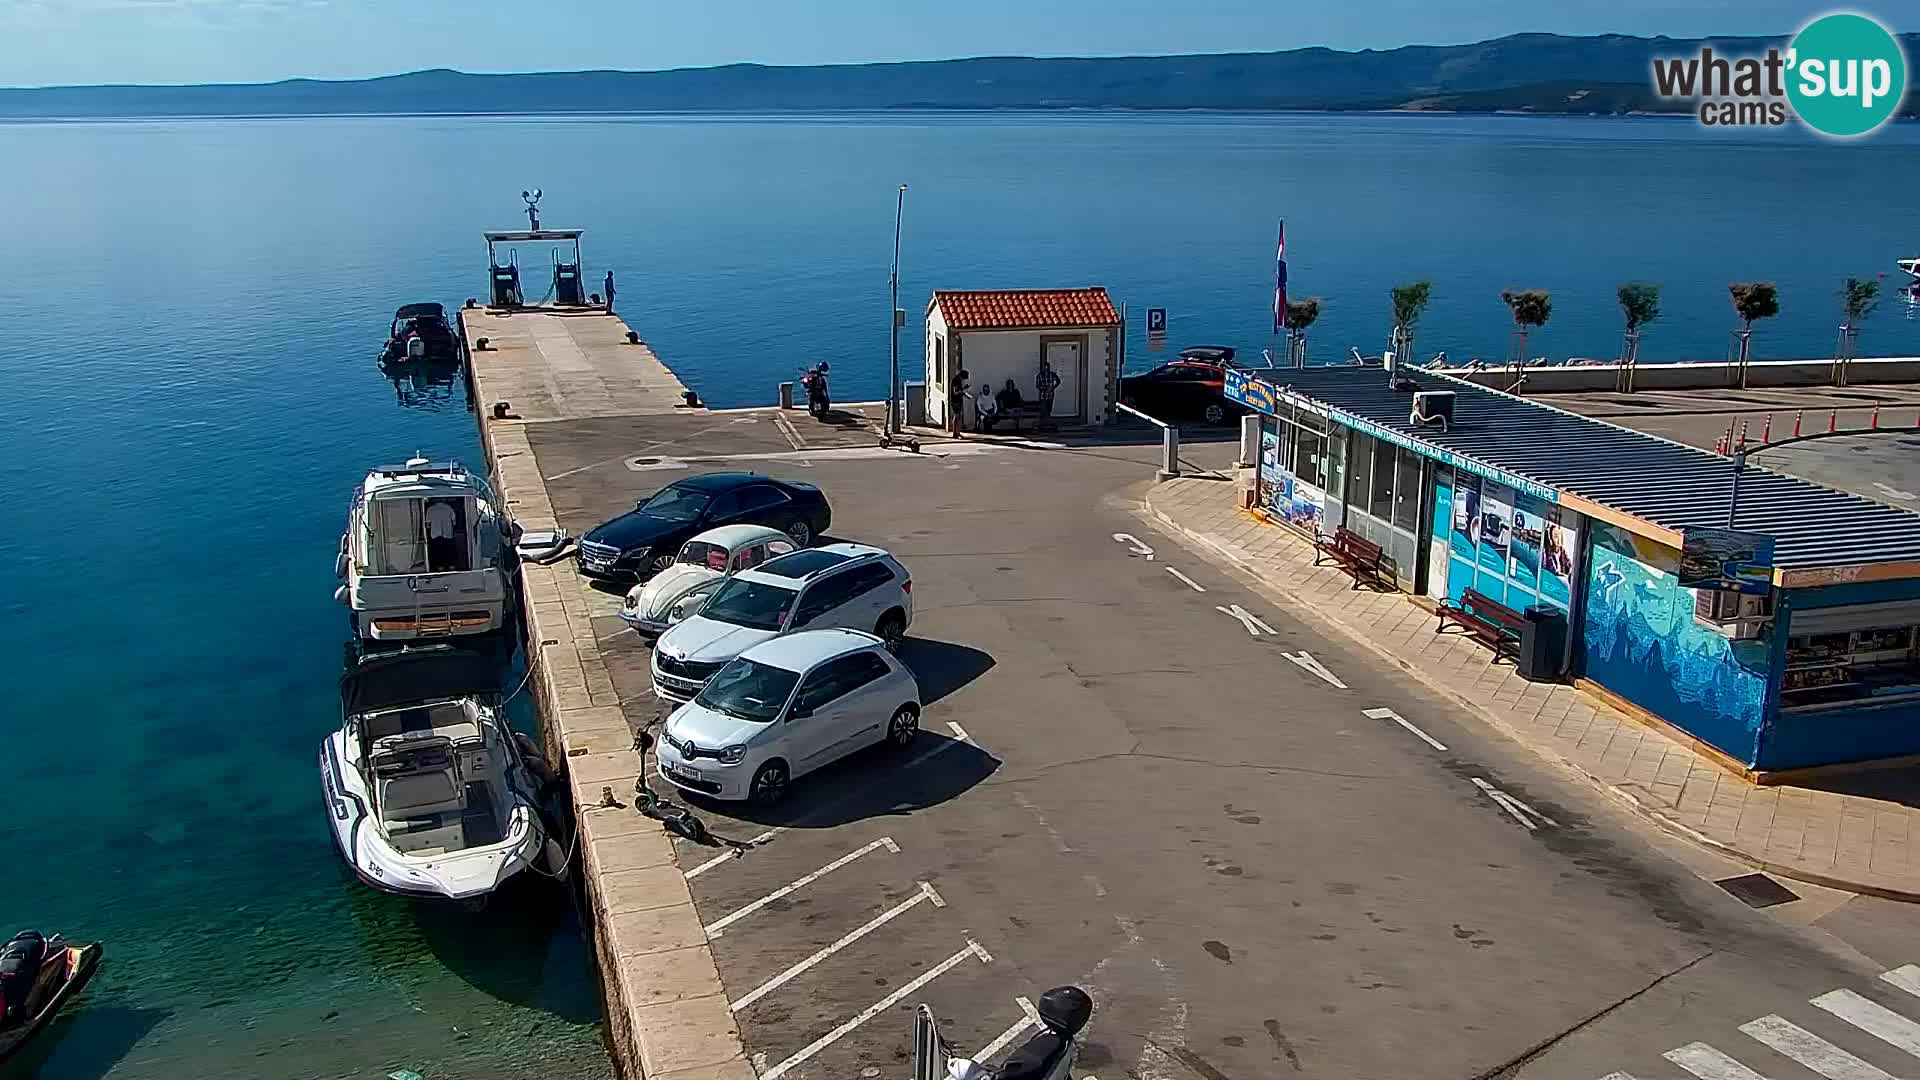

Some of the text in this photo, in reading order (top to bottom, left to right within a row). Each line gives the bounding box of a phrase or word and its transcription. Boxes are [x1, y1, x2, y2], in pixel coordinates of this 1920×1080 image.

[1412, 440, 1442, 458] POSTAJA
[1451, 454, 1466, 467] BUS
[1467, 460, 1499, 479] STATION
[1500, 473, 1525, 491] TICKET
[1526, 482, 1554, 500] OFFICE
